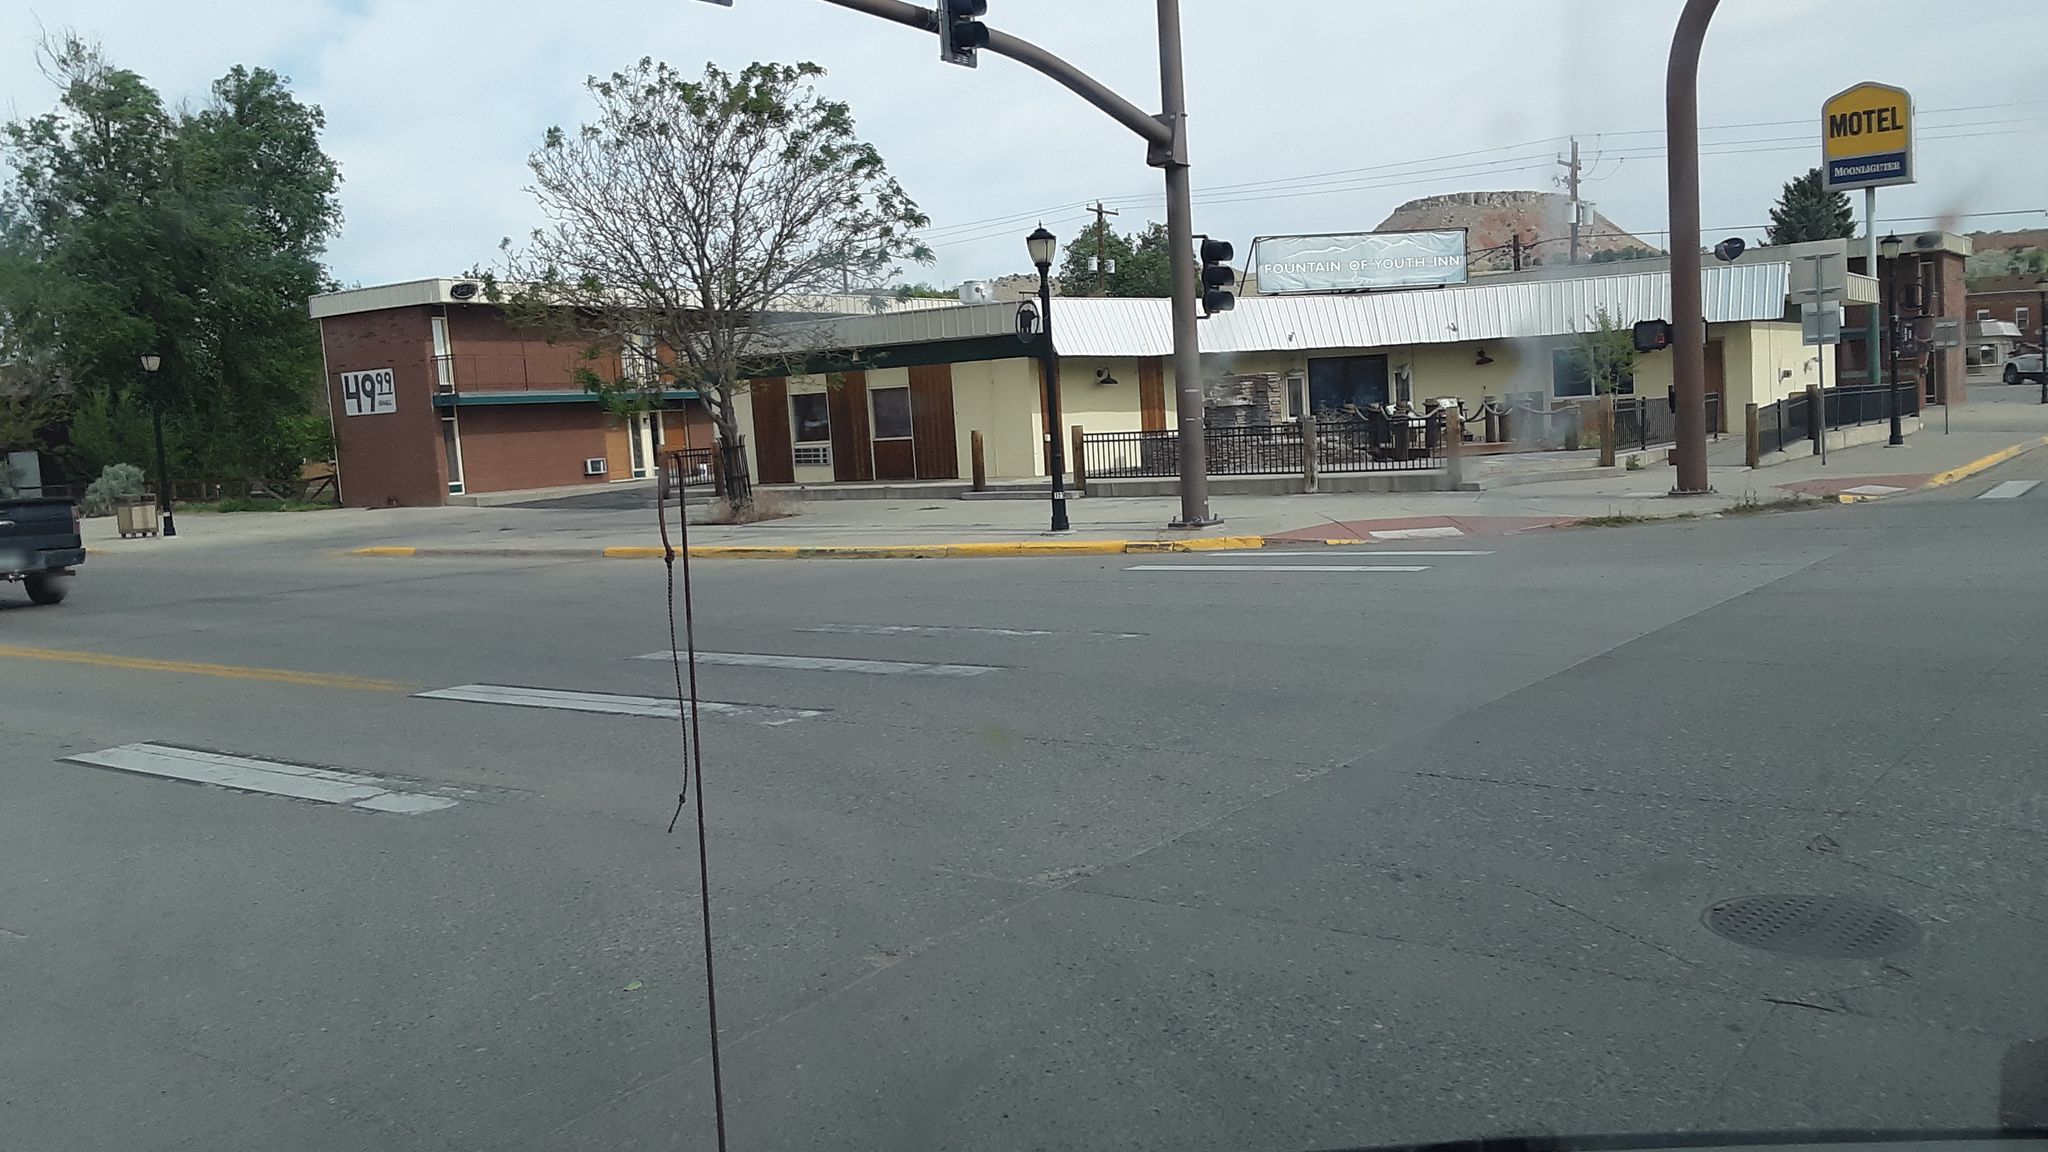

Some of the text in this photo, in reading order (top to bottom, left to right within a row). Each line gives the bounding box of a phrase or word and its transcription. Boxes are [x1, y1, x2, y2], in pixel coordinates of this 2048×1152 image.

[1829, 106, 1904, 138] MOTEL
[1264, 255, 1460, 275] FOUNTAIN OF YOUTH INN
